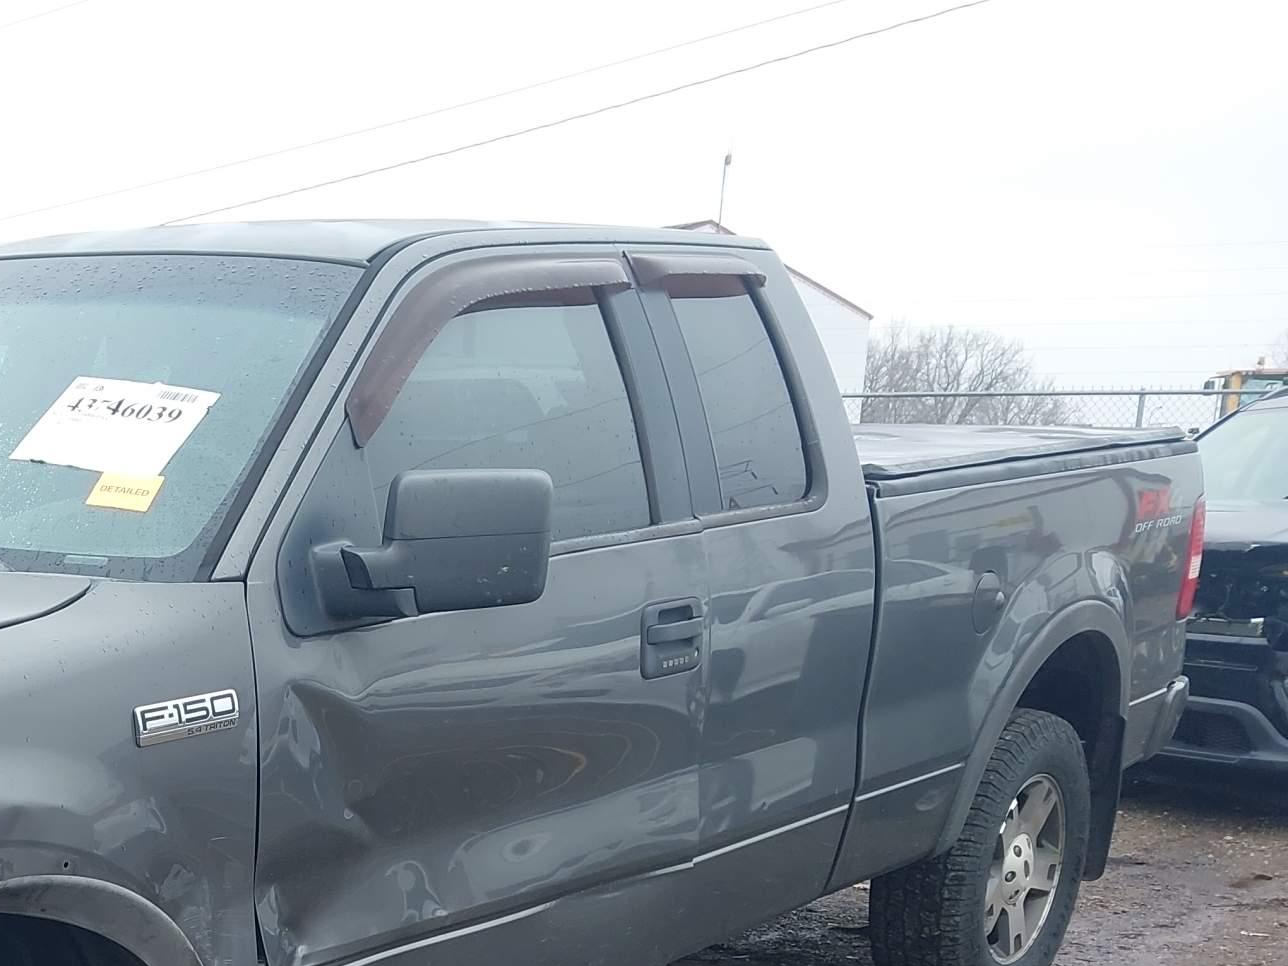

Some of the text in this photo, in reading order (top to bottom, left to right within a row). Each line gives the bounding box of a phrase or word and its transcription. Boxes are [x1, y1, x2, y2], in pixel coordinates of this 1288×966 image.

[99, 484, 150, 497] DETAILED
[1135, 514, 1182, 533] OFF ROAD
[139, 693, 236, 732] F-150
[205, 718, 237, 731] TRITON
